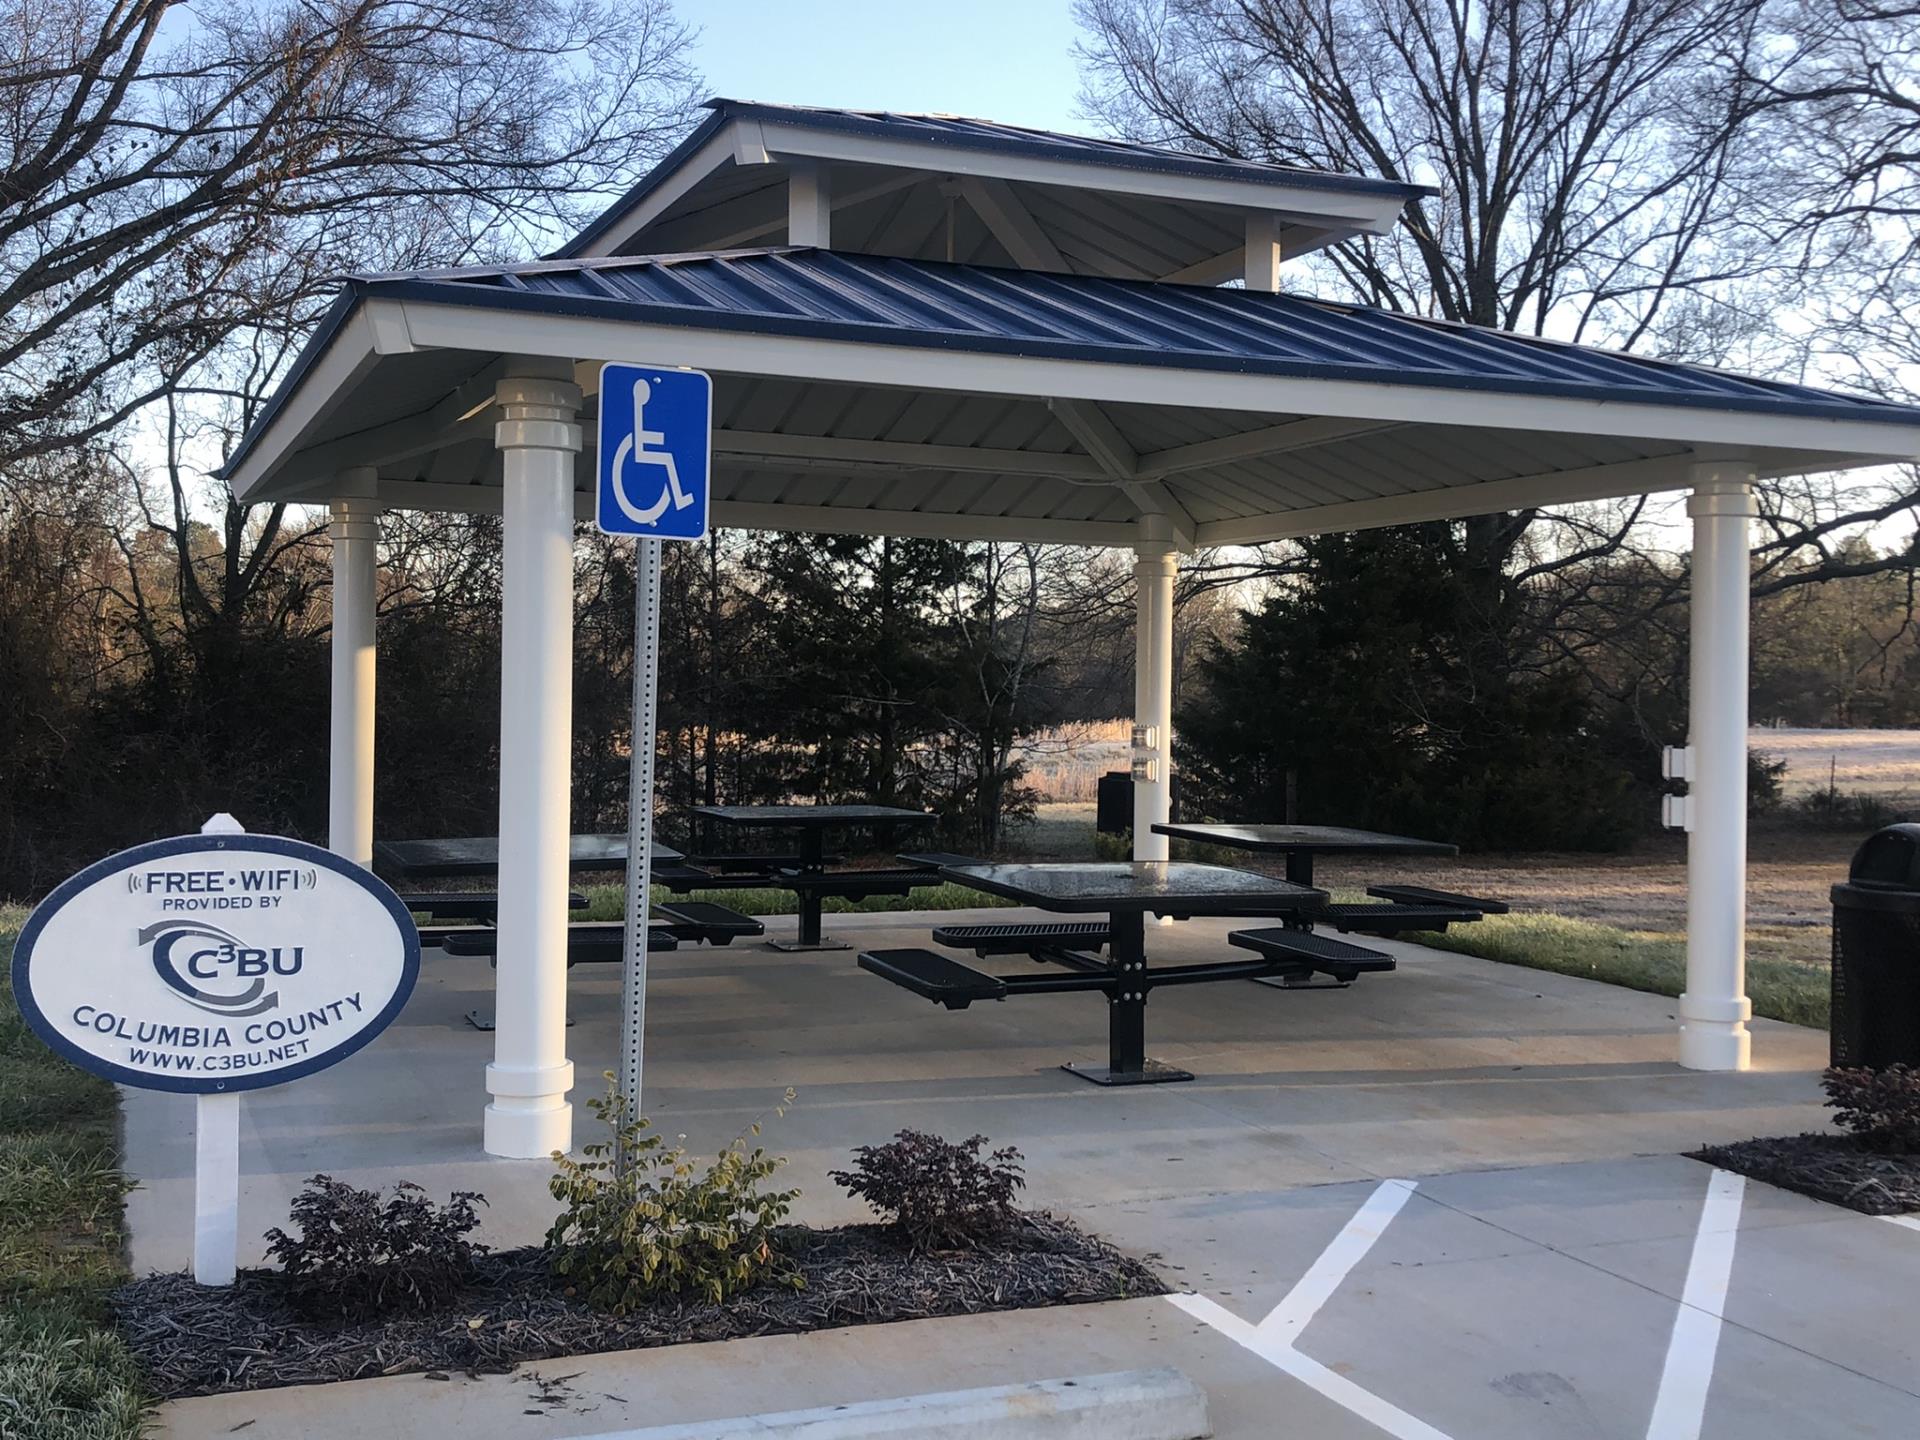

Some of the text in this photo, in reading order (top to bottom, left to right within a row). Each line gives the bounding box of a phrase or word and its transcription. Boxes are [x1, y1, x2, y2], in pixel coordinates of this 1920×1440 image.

[146, 870, 299, 893] FREE WIFI
[162, 896, 282, 911] PROVIDED BY
[73, 992, 364, 1047] COLUMBIA COUNTY
[129, 1038, 310, 1071] WWW.C3BU.NET
